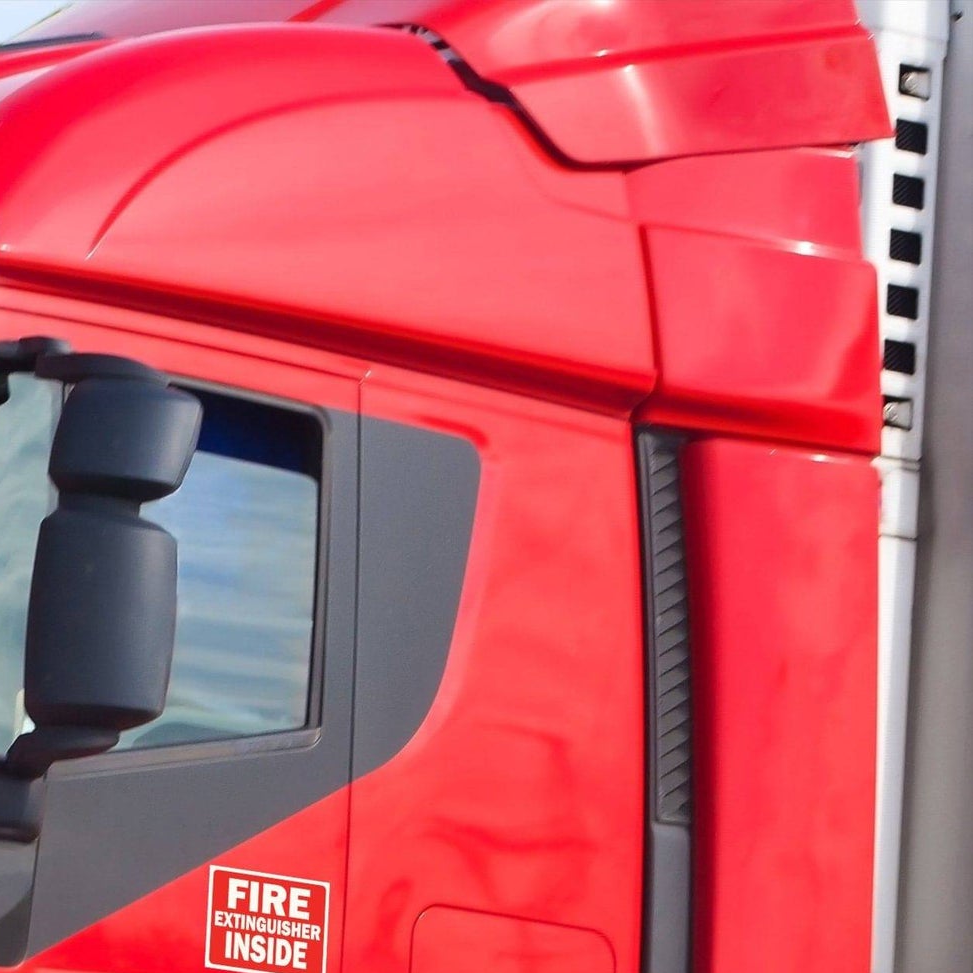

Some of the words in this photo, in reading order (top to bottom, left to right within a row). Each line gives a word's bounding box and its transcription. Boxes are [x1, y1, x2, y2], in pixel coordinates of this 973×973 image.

[227, 877, 311, 920] FIRE
[214, 910, 321, 941] EXTINGUISHER
[224, 930, 308, 970] INSIDE
